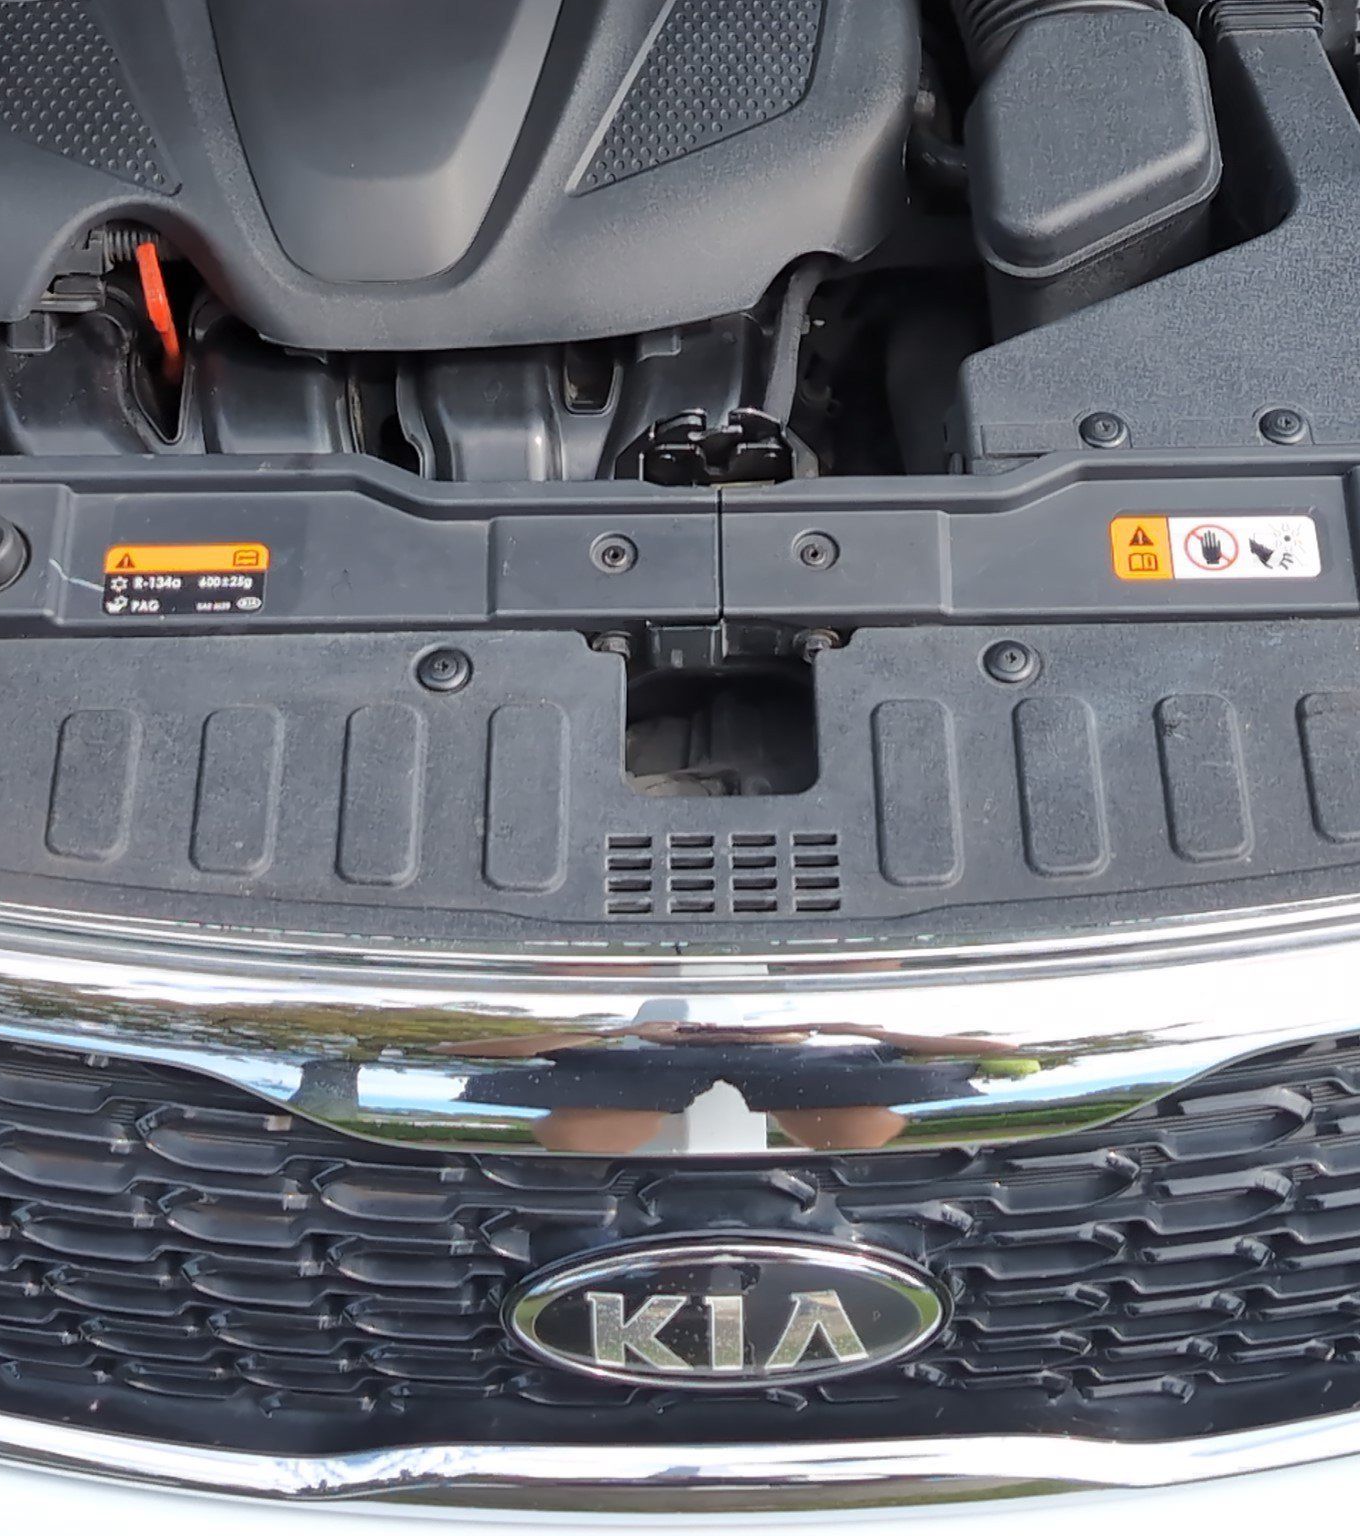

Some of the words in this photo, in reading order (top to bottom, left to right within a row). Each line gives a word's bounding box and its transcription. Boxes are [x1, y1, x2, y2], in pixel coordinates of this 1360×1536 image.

[133, 575, 182, 590] R-134a
[130, 599, 160, 613] PAG
[585, 1289, 870, 1371] KIA
